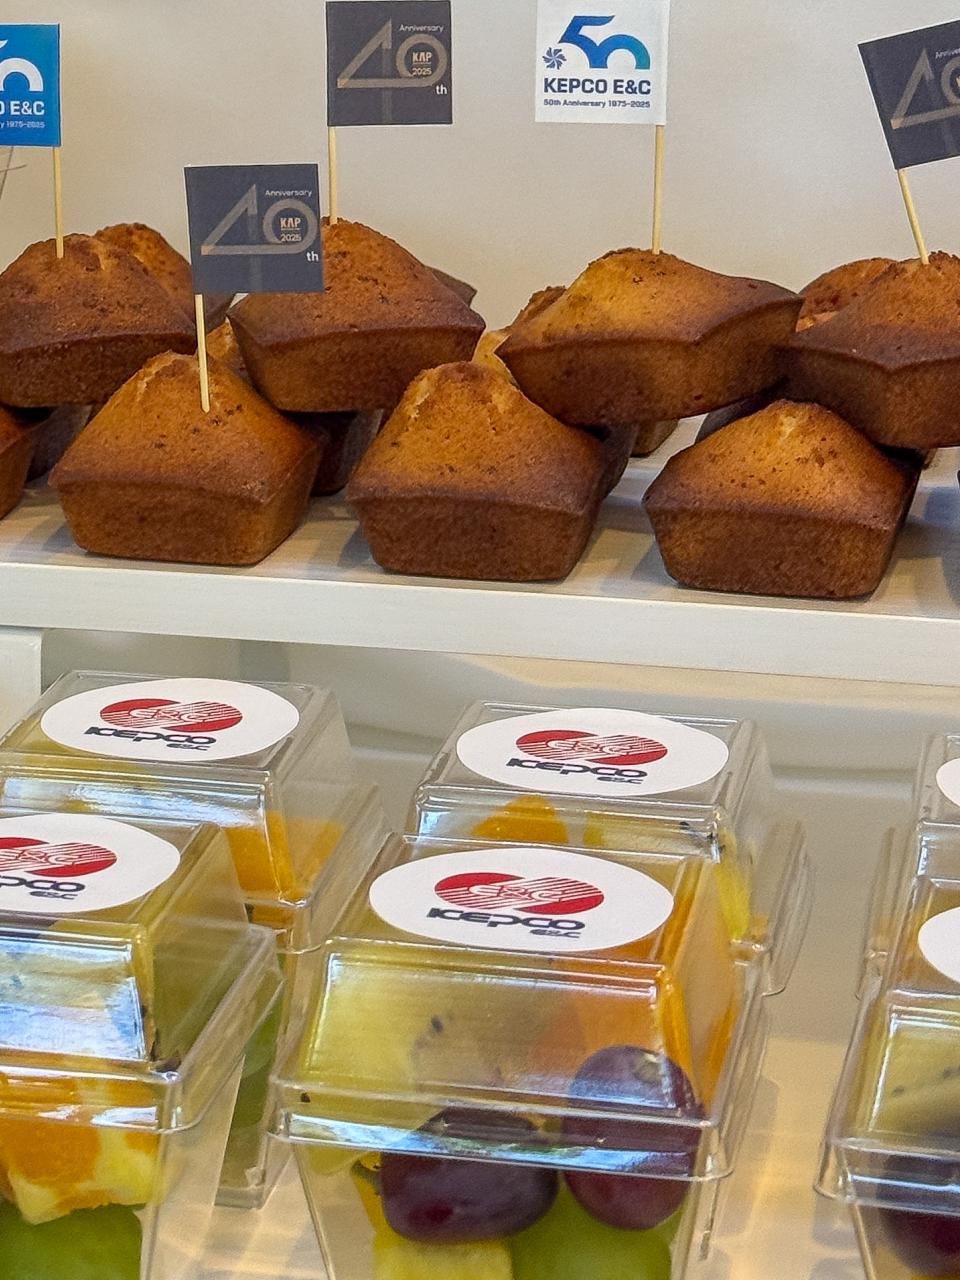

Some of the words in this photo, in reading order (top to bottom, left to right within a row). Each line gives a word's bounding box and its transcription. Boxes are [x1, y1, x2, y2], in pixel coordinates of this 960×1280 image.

[399, 24, 444, 32] Anniversary
[436, 84, 447, 95] th
[544, 78, 608, 94] KEPCO
[613, 79, 650, 95] E&C
[10, 101, 44, 115] E&C
[563, 100, 606, 108] Anniversary
[280, 234, 301, 242] 2025
[306, 251, 319, 262] th
[84, 726, 217, 744] KEPCO
[506, 758, 648, 778] KEPCO
[427, 907, 585, 930] KEPCO
